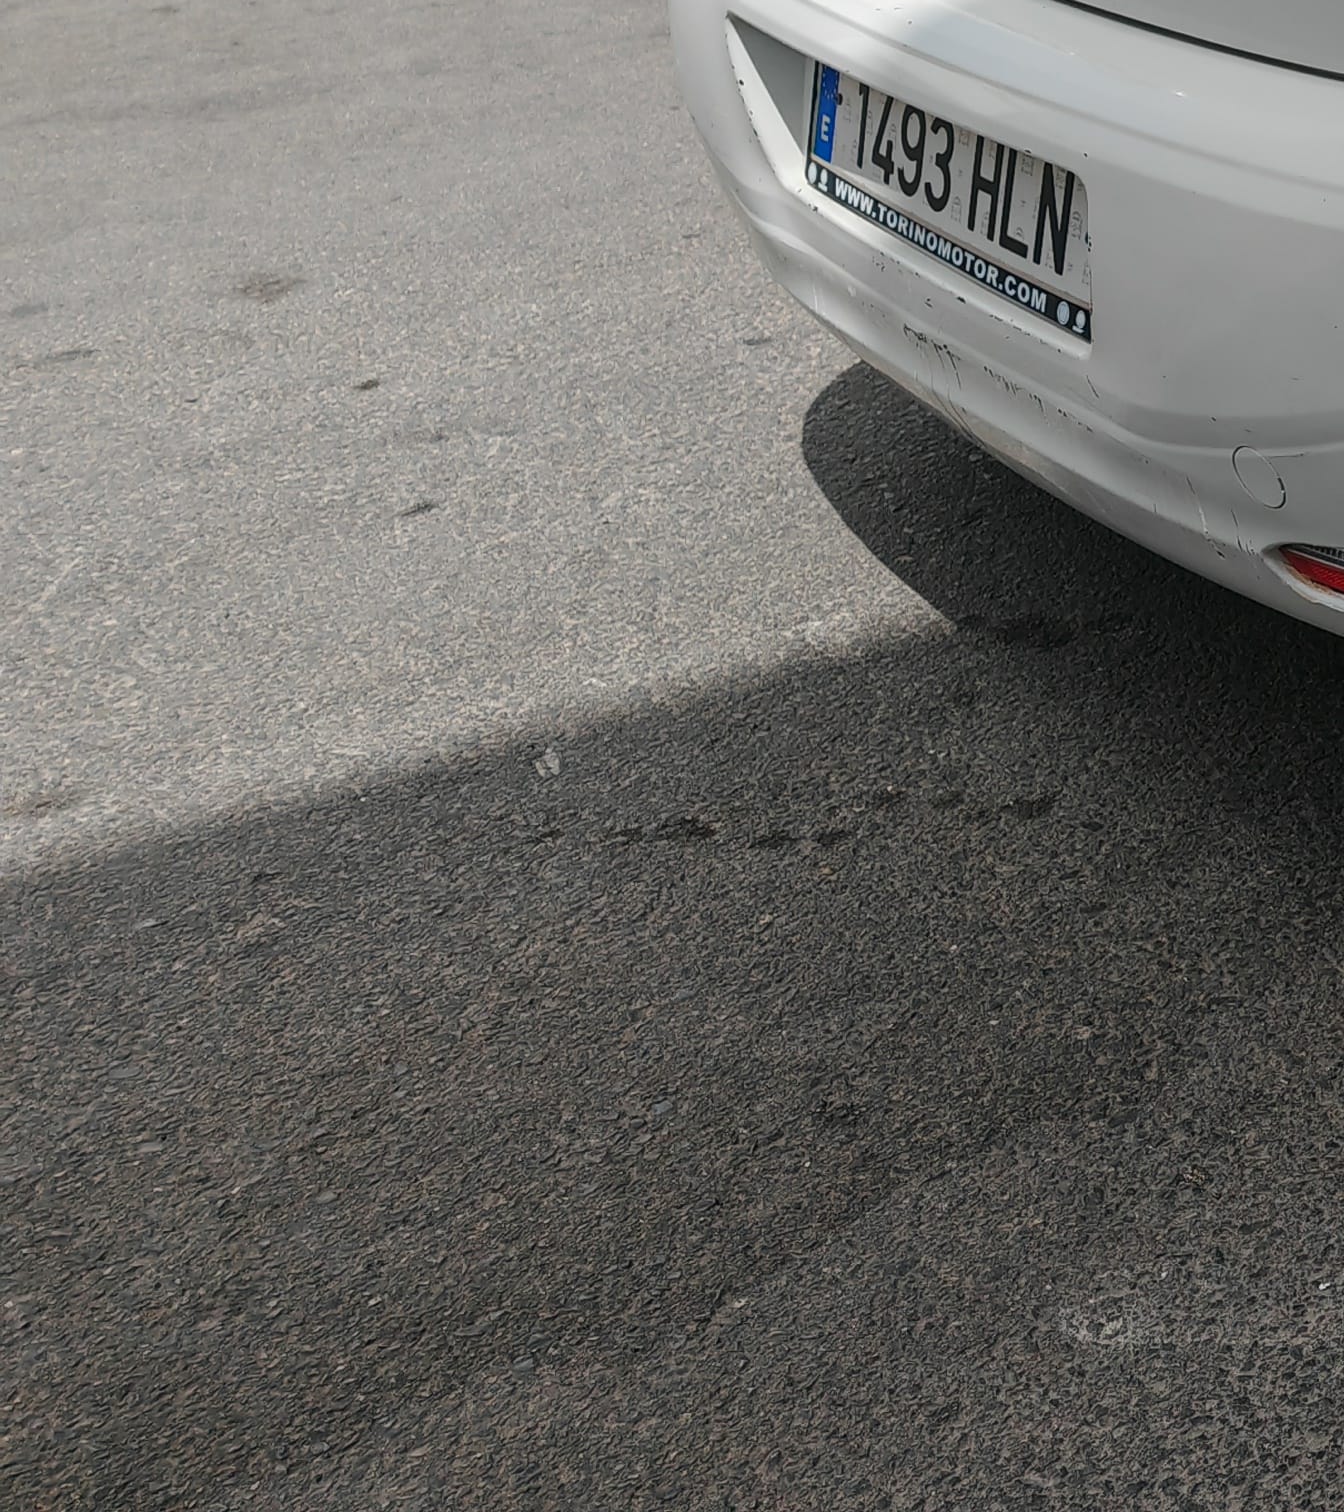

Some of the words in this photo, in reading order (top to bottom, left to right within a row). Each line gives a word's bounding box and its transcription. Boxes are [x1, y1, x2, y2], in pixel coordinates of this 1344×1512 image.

[819, 113, 832, 142] E
[855, 81, 956, 213] 1493
[966, 134, 1076, 277] HLN
[833, 176, 1048, 315] WWW.TORINOMOTOR.COM
